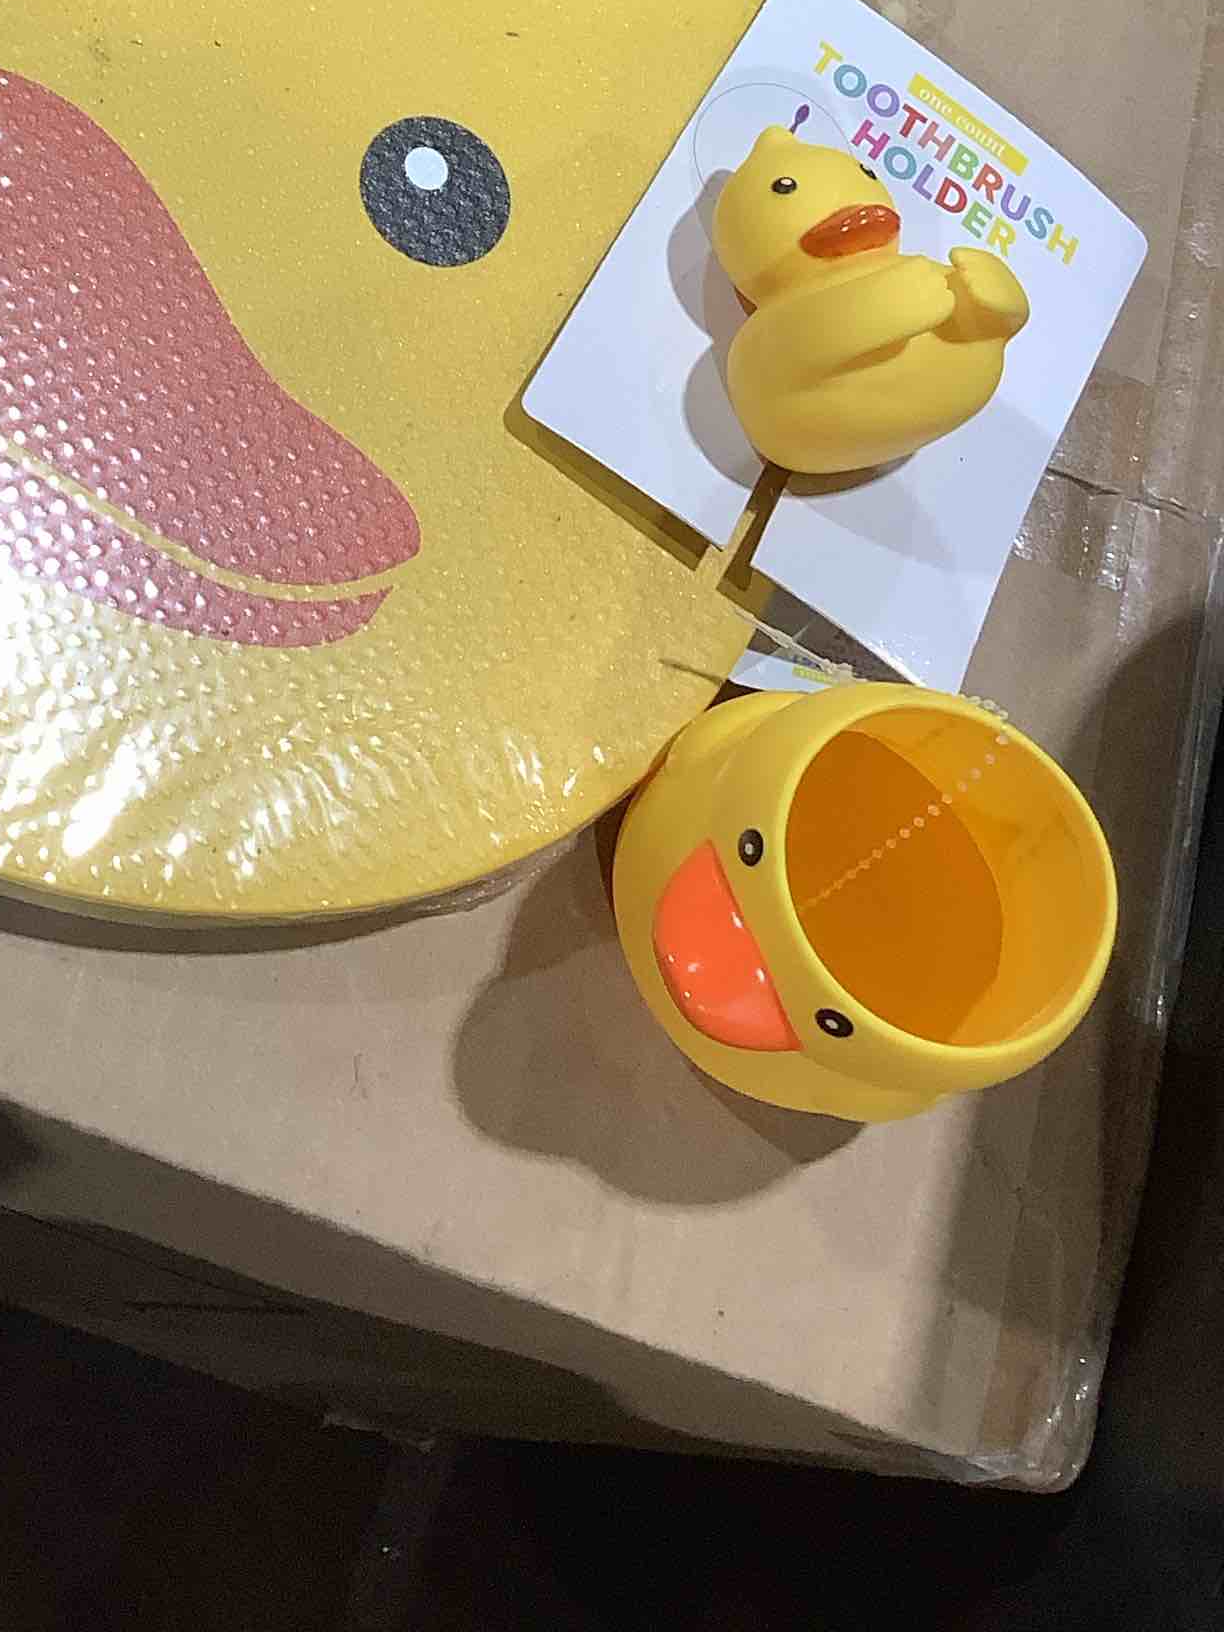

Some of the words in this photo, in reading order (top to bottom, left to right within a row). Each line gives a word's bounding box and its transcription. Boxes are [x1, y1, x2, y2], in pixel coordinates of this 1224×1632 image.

[814, 40, 1078, 265] TOOTHBRUSH
[851, 119, 1016, 257] HOLDER
[919, 87, 952, 115] one
[956, 114, 1005, 157] count
